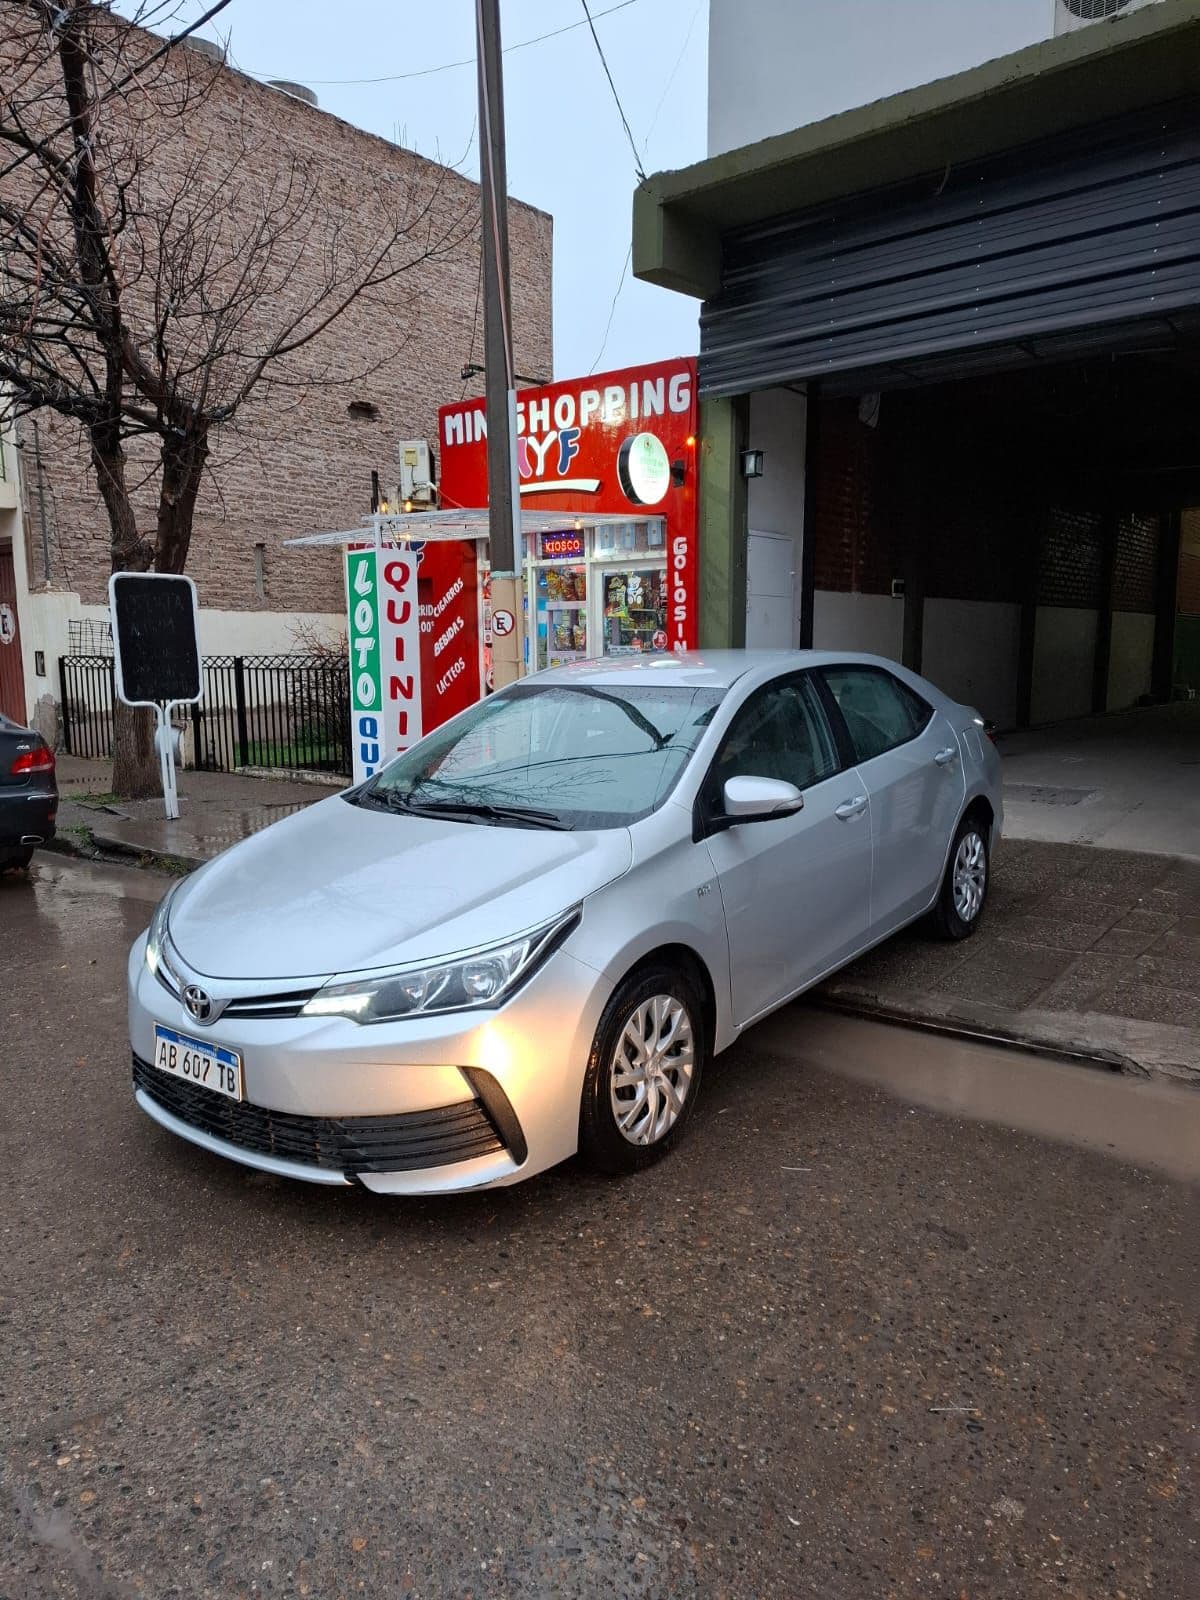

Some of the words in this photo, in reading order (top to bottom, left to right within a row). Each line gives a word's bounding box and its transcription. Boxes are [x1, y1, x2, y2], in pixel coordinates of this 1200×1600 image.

[545, 540, 580, 552] KIOSCO
[433, 576, 464, 618] CIGARROS
[353, 559, 375, 707] LOTO
[433, 616, 465, 657] BEBIDAS
[383, 560, 414, 752] QUINI
[436, 657, 466, 695] LACTEOS
[160, 1042, 177, 1069] AB
[183, 1051, 210, 1082] 607
[217, 1063, 235, 1093] TB
